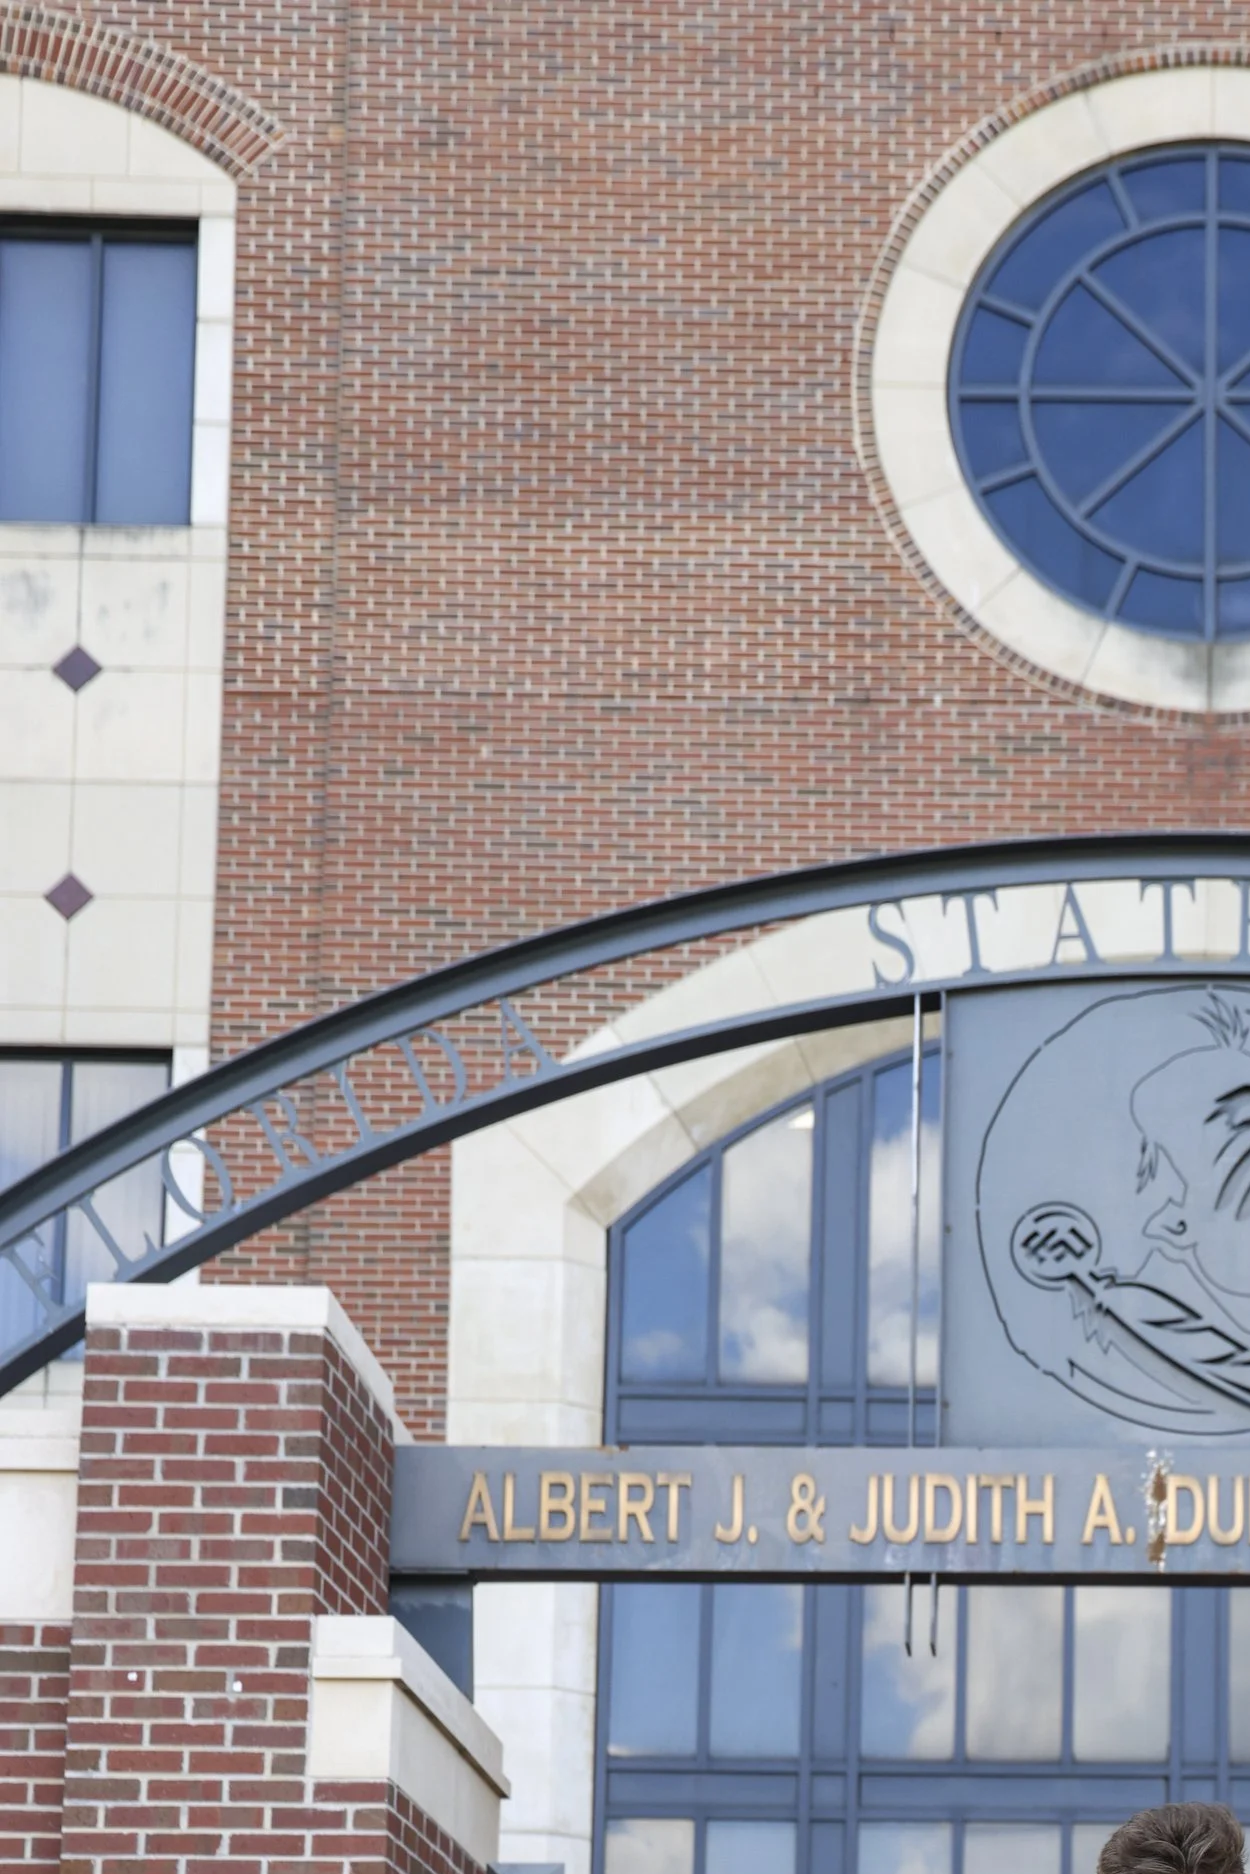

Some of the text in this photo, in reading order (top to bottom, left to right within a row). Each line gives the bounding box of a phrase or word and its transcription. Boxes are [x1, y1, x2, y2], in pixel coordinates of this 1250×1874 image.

[2, 999, 565, 1328] FLORIDA
[458, 1470, 693, 1544] ALBERT
[714, 1473, 759, 1545] J.
[786, 1473, 826, 1545] &
[848, 1473, 1054, 1546] JUDITH
[1081, 1473, 1137, 1546] A.
